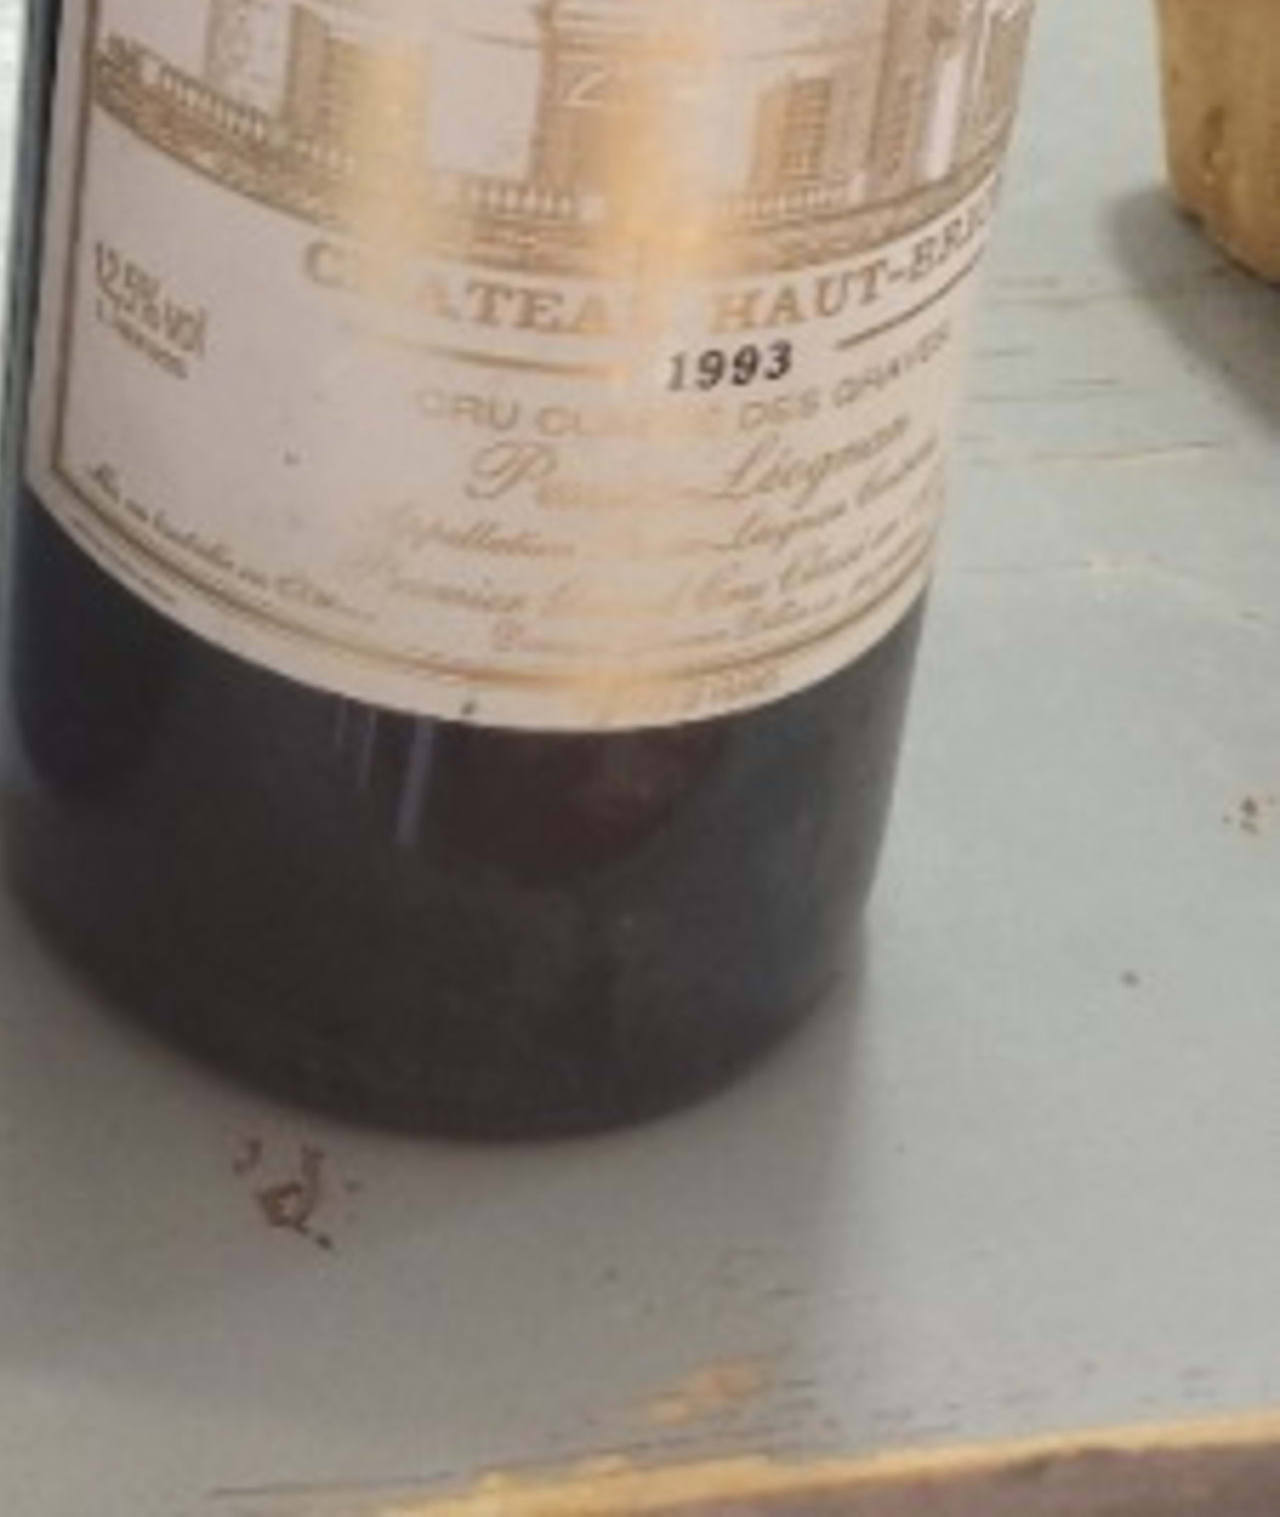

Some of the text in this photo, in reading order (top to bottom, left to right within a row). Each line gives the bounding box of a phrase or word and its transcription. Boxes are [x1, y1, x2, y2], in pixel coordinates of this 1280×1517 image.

[710, 204, 986, 336] HAUT-BRI
[665, 338, 794, 393] 1993
[417, 386, 522, 432] CRU
